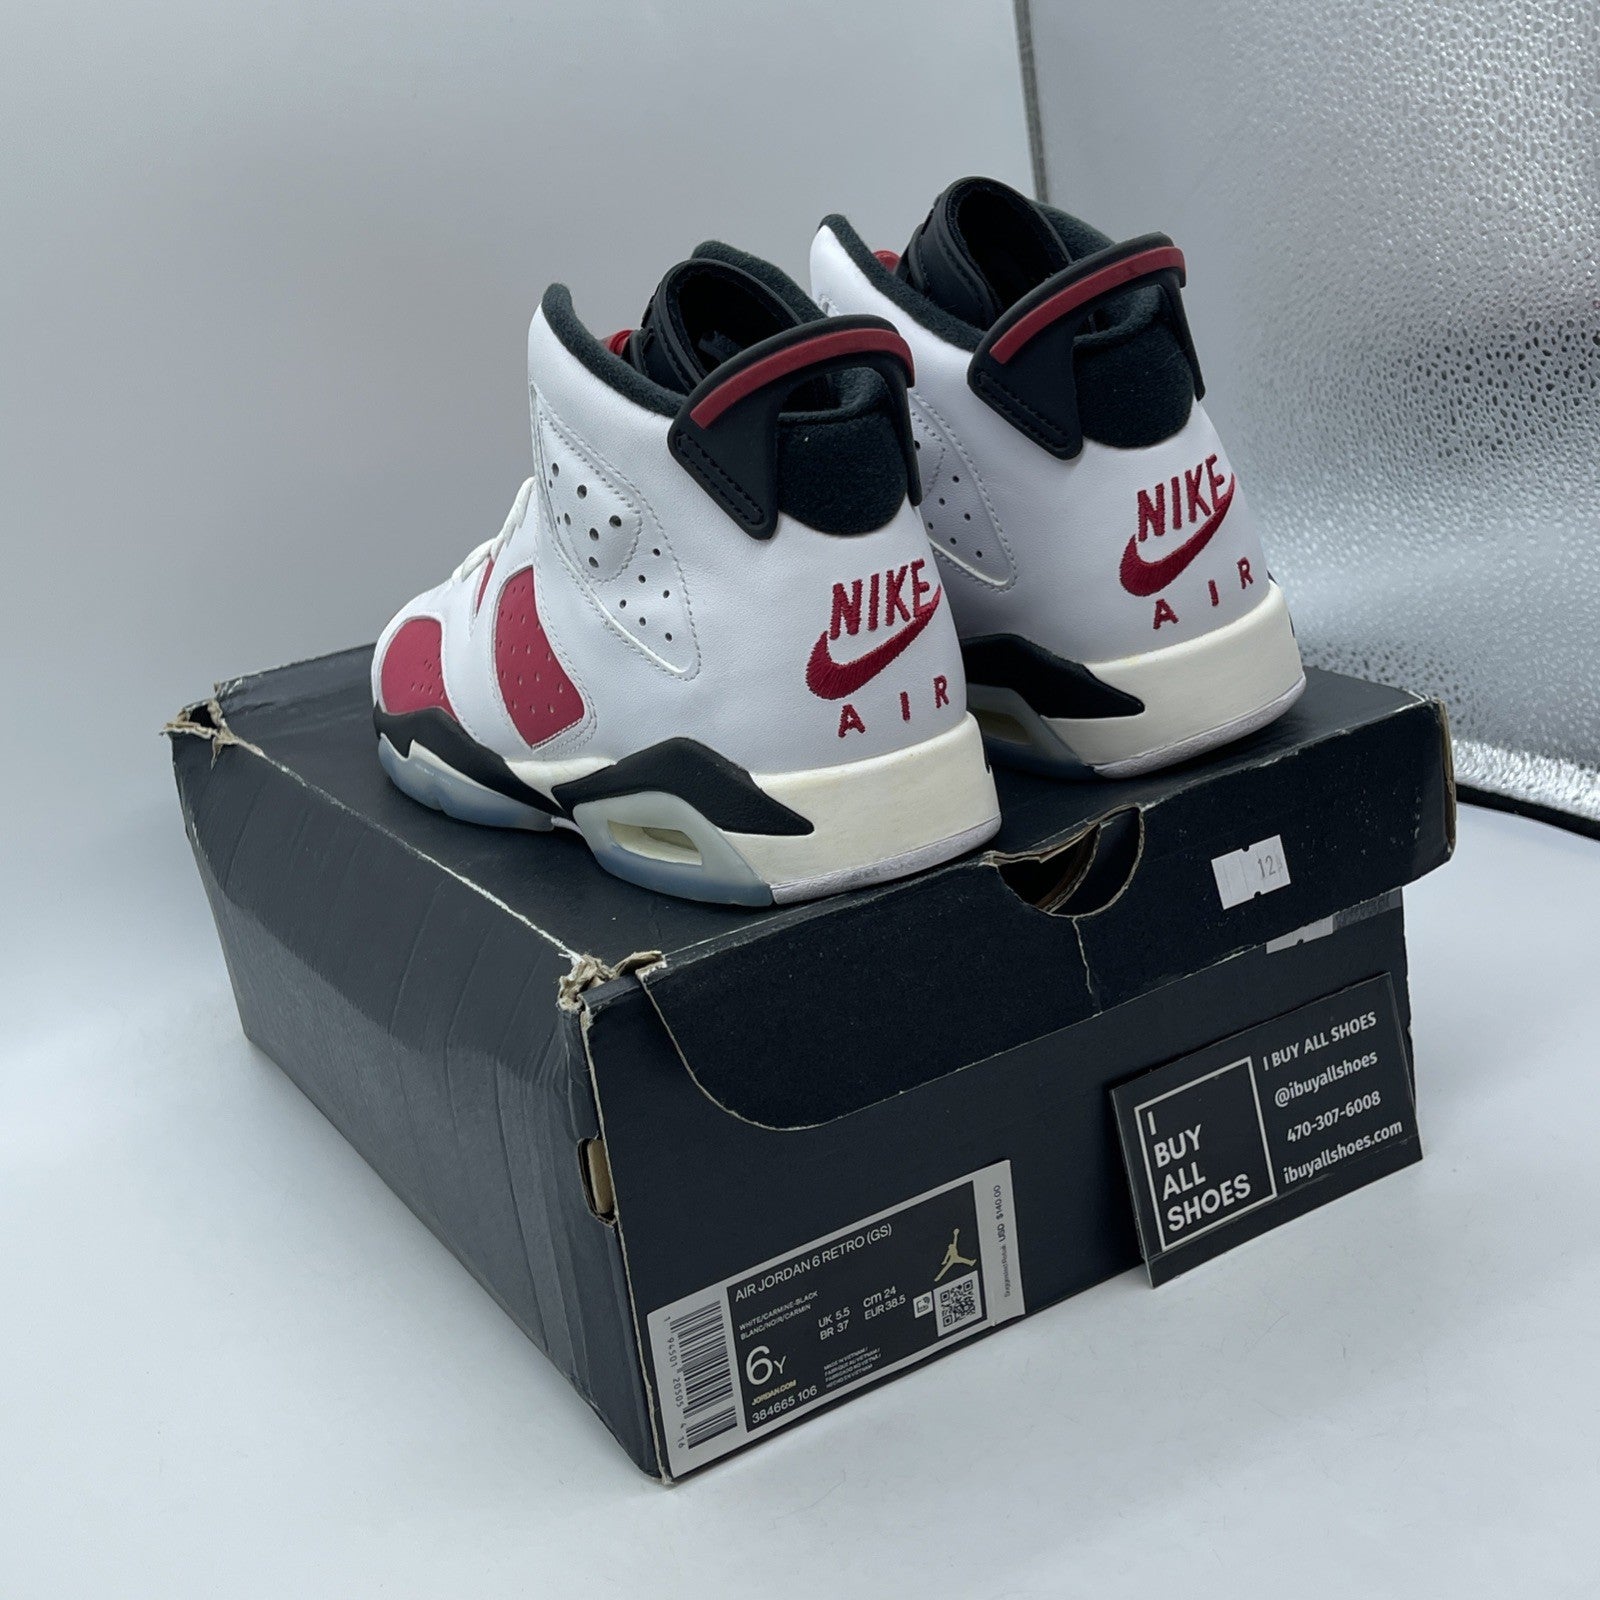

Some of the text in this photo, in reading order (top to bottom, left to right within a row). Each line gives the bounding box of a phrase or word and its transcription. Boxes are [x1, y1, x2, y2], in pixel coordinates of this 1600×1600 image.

[1137, 453, 1228, 542] NIKE
[829, 558, 933, 640] NIKE
[1153, 557, 1253, 630] AIR
[838, 675, 949, 738] AIR
[1263, 1011, 1377, 1071] I BUY ALL SHOES
[1275, 1051, 1378, 1107] @ibuyallshoes
[1147, 1111, 1157, 1136] I
[1287, 1090, 1381, 1142] 470-307-6008
[1153, 1124, 1201, 1168] BUY
[1283, 1121, 1403, 1184] ibuyallshoes.com
[1163, 1161, 1206, 1201] ALL
[1167, 1173, 1251, 1231] SHOES
[993, 1185, 1004, 1220] $140.00
[997, 1223, 1006, 1242] USD
[736, 1223, 892, 1302] AIR JORDAN 6 RETRO (GS)
[818, 1306, 851, 1328] UK 5.5
[863, 1285, 896, 1308] cm 24
[864, 1294, 906, 1320] EUR 38.5
[820, 1319, 849, 1340] BR 37
[673, 1377, 684, 1408] 20505
[752, 1380, 797, 1405] JORDAN.COM
[752, 1385, 818, 1424] 384665 106
